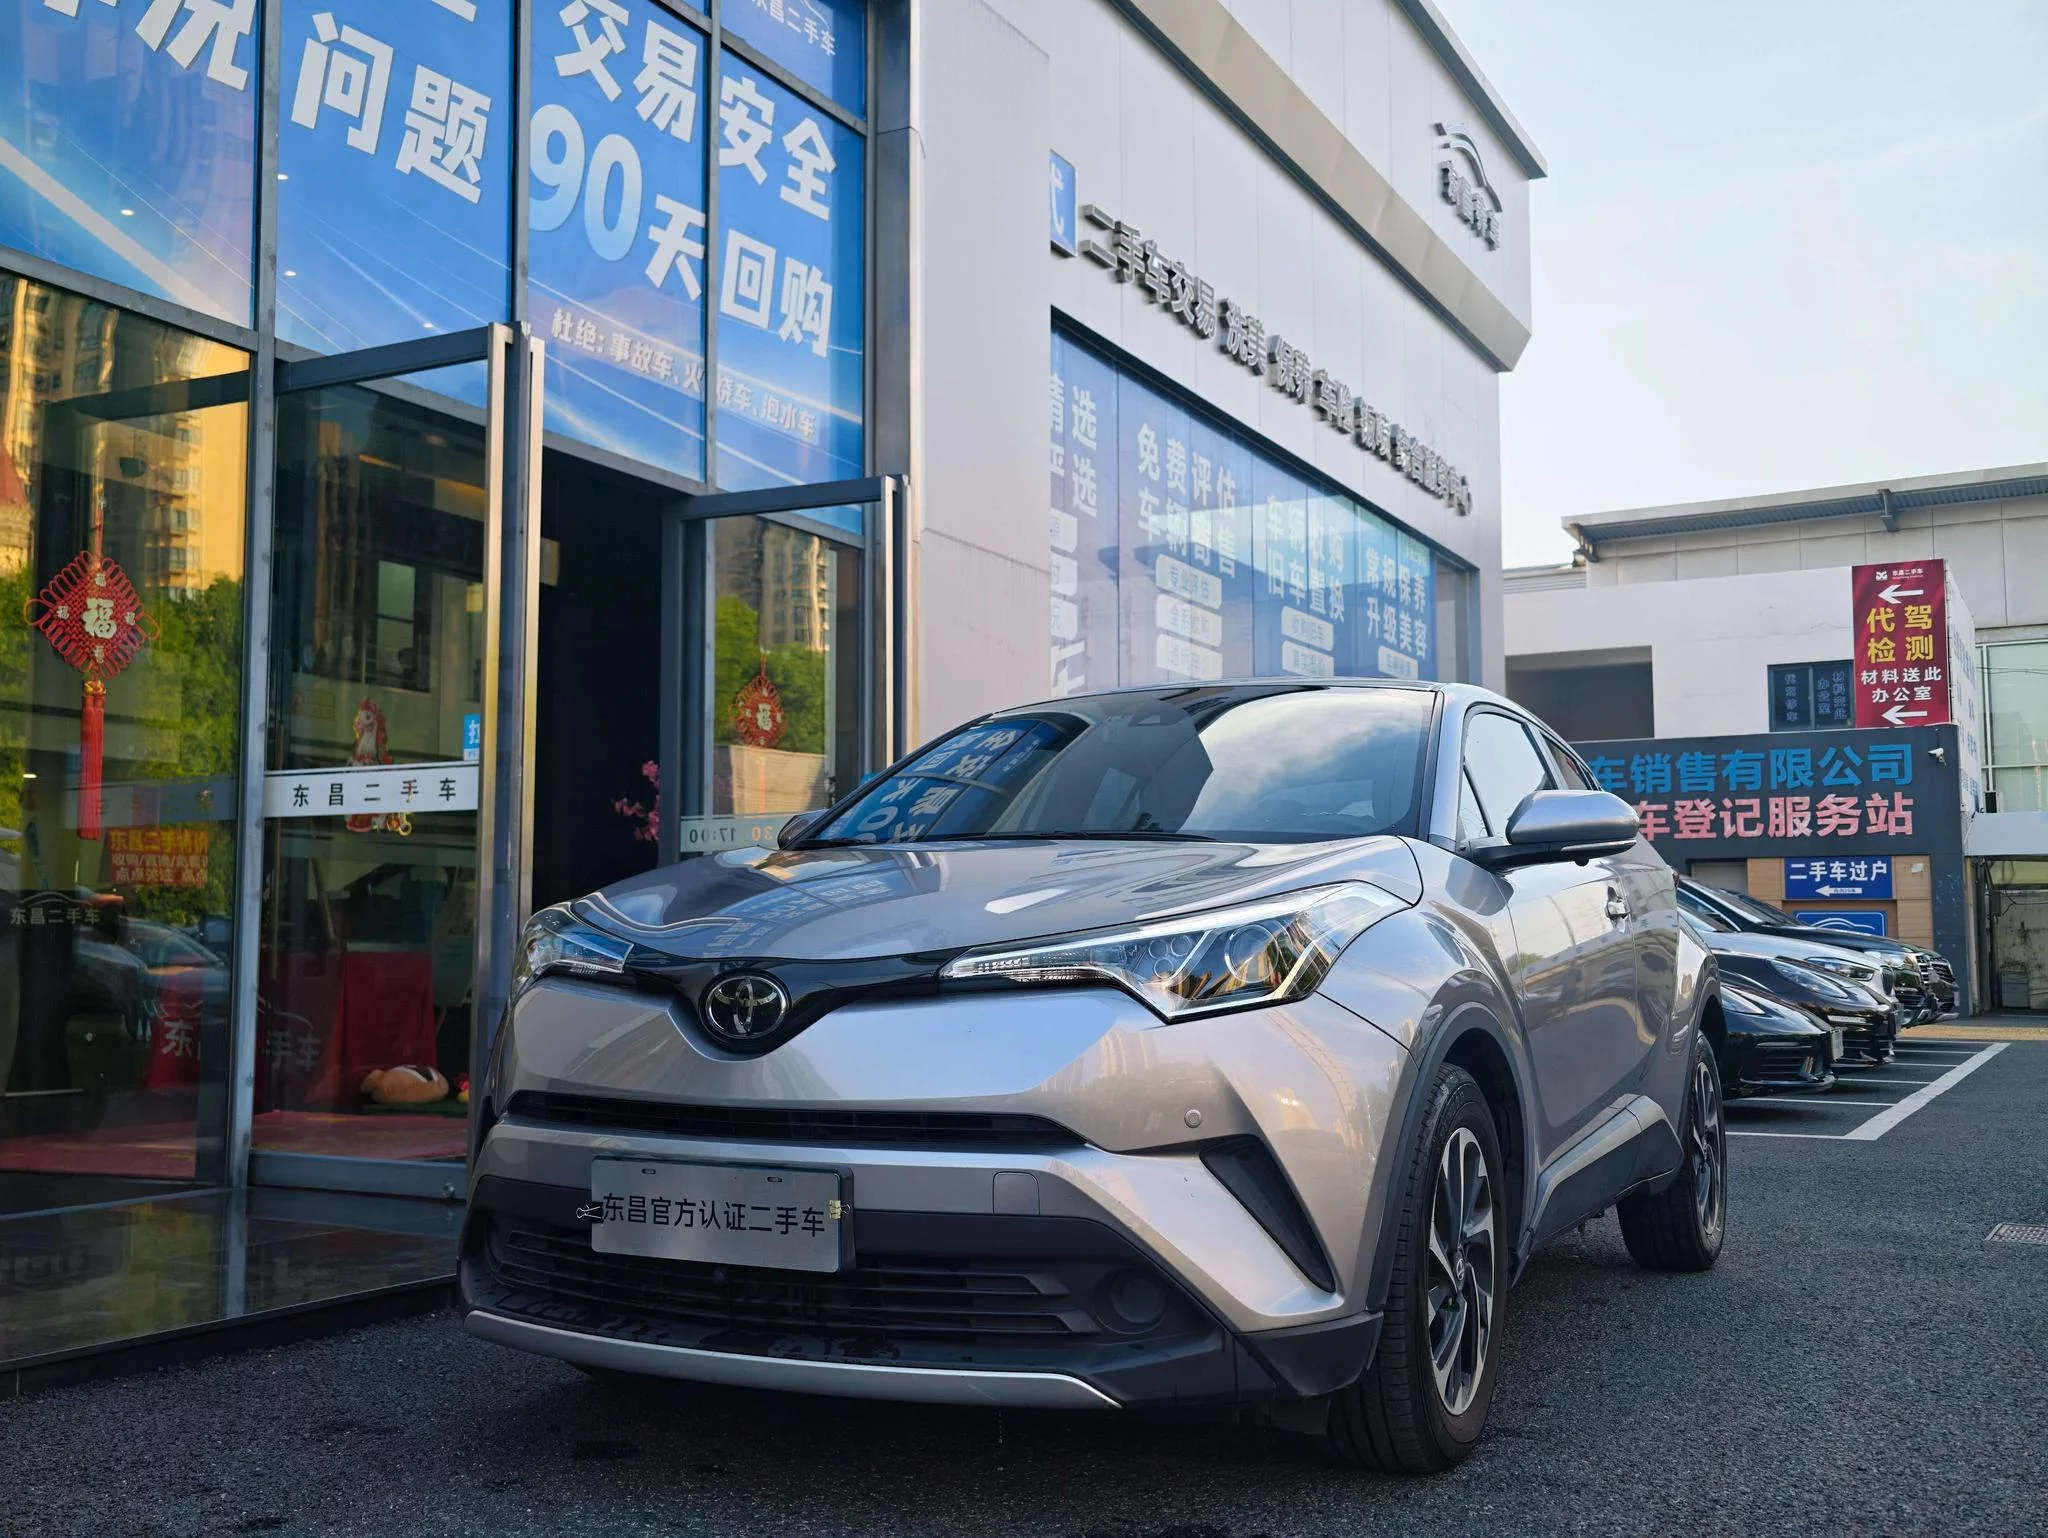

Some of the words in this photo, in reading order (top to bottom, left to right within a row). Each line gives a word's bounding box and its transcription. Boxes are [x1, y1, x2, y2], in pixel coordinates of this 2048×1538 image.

[554, 0, 837, 221] 交易安全
[1078, 203, 1216, 340] 二手车交易
[1266, 335, 1313, 404] 保养
[1137, 422, 1238, 522] 免费评估
[1268, 549, 1345, 624] 旧车置换
[1366, 546, 1426, 614] 常规保养
[82, 598, 117, 639] 福
[1367, 596, 1428, 660] 升级美容
[1867, 604, 1933, 634] 代驾
[1867, 636, 1934, 664] 检测
[1861, 666, 1942, 685] 材料送此
[1872, 686, 1932, 703] 办公室
[293, 778, 456, 807] 东昌二手车
[1790, 860, 1887, 882] 二手车过户
[10, 906, 101, 925] 东昌二手车
[603, 1192, 825, 1238] 东昌官方认证二手车
